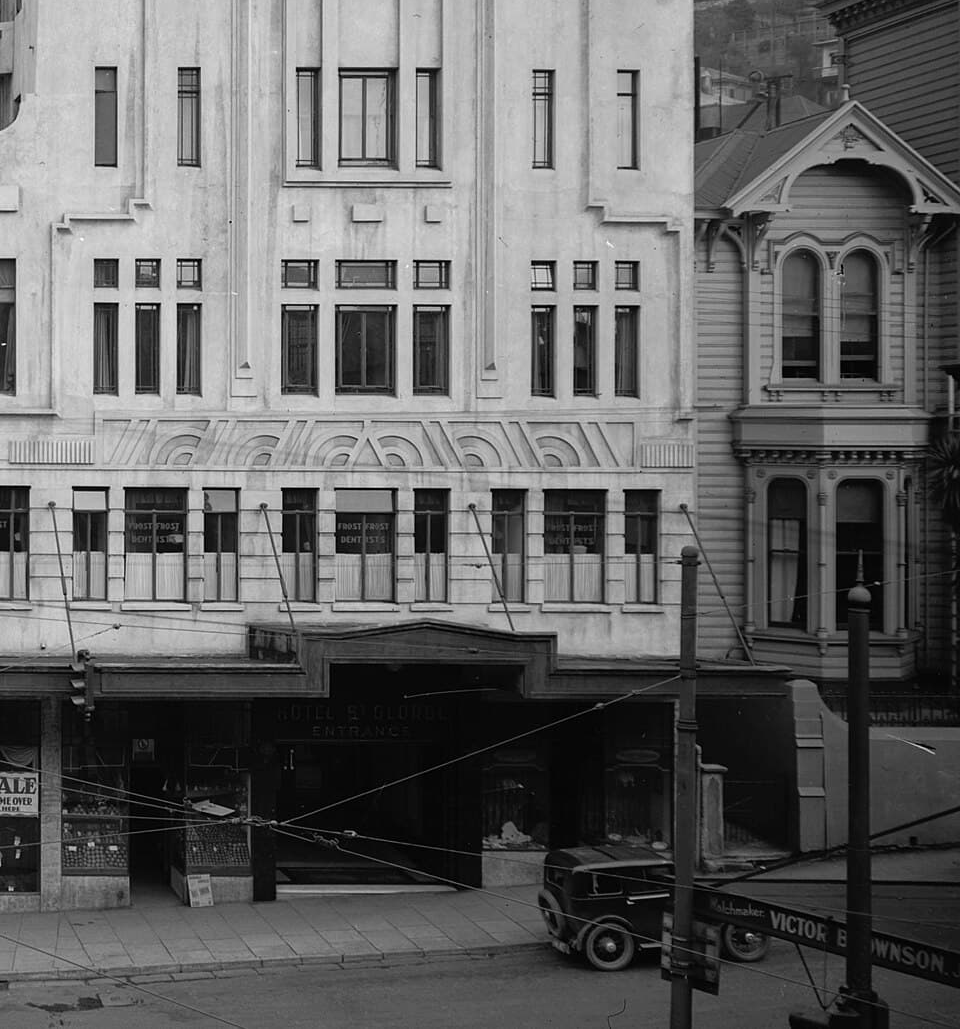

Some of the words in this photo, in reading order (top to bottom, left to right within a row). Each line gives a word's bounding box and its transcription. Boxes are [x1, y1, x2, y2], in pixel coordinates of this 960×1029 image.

[337, 522, 362, 531] FROST
[365, 523, 390, 531] FROST
[340, 535, 385, 544] DENTISTS
[276, 704, 336, 722] HOTEL
[373, 704, 449, 722] GEORGE
[311, 725, 410, 739] ENTRANCE
[12, 797, 33, 807] OVER
[769, 910, 828, 944] VICTOR
[836, 927, 949, 977] BWNSON.
